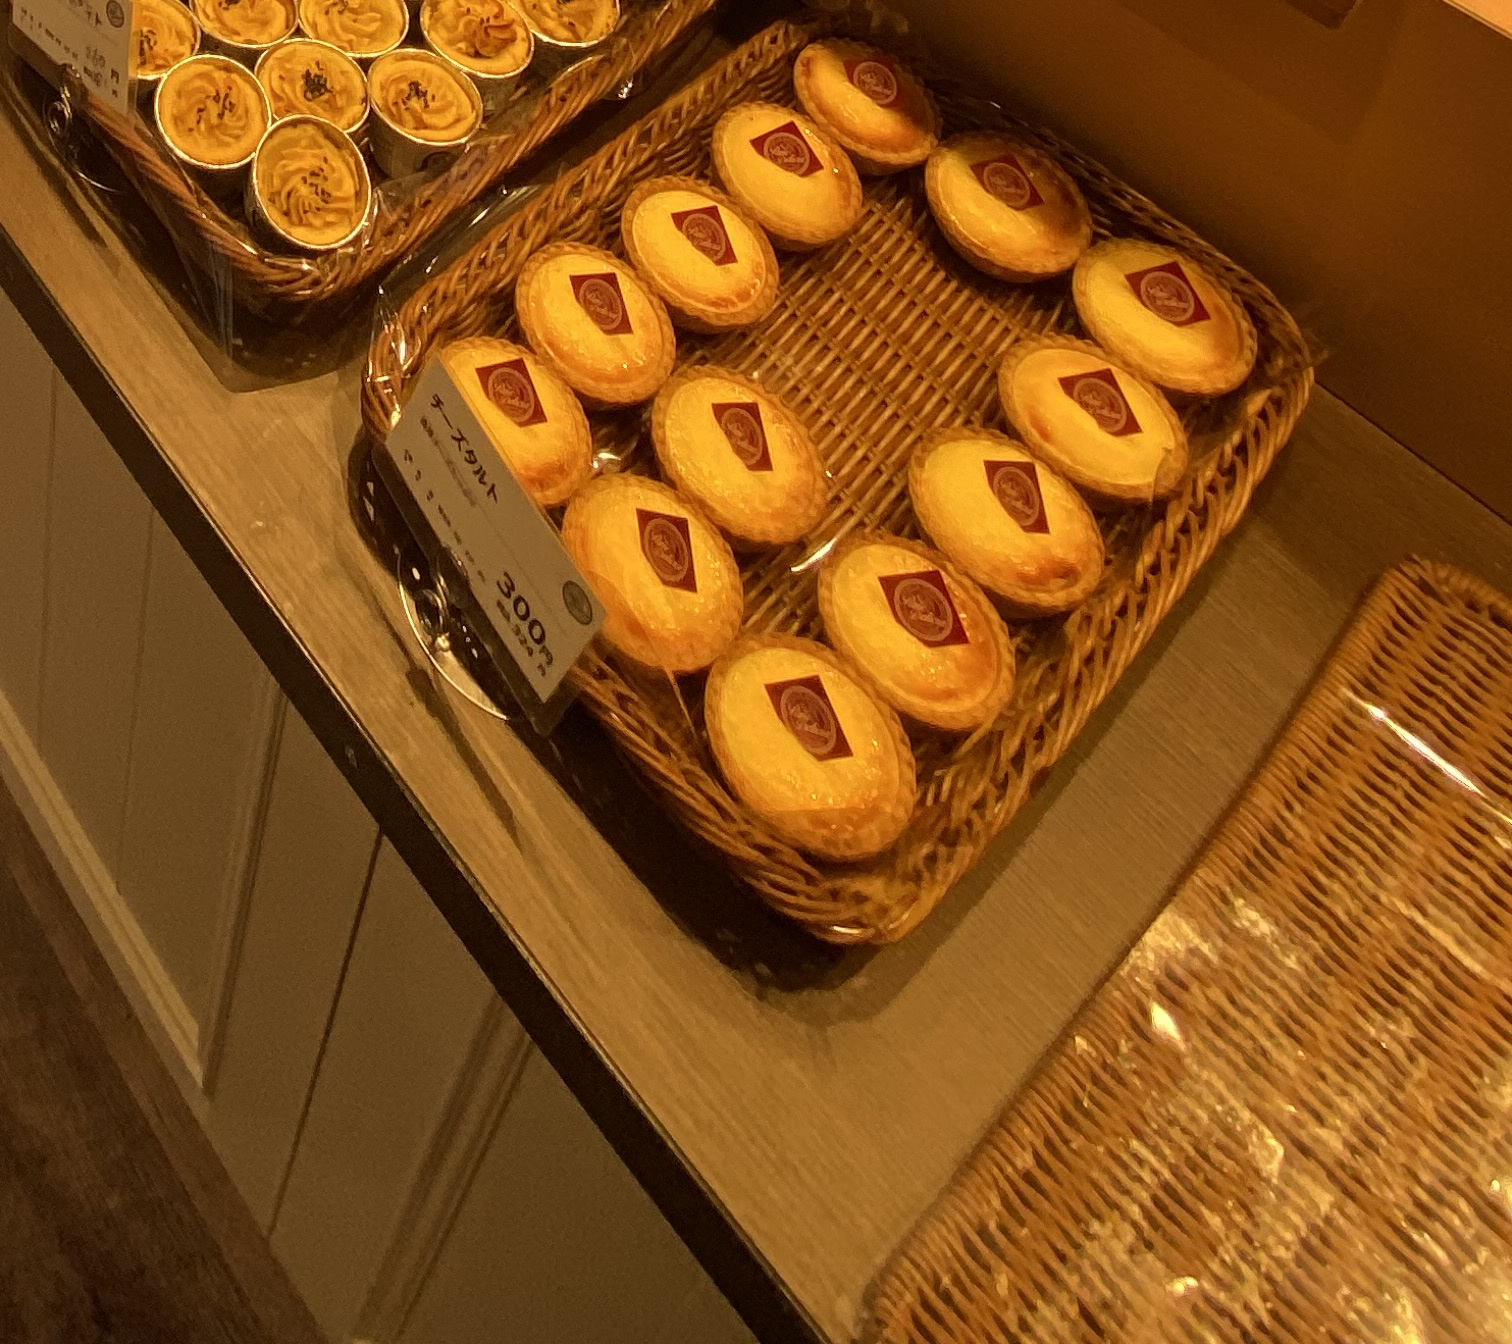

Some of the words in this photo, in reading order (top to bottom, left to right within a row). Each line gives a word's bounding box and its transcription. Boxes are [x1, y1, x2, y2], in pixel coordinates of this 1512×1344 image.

[429, 392, 500, 505] チーズタルト
